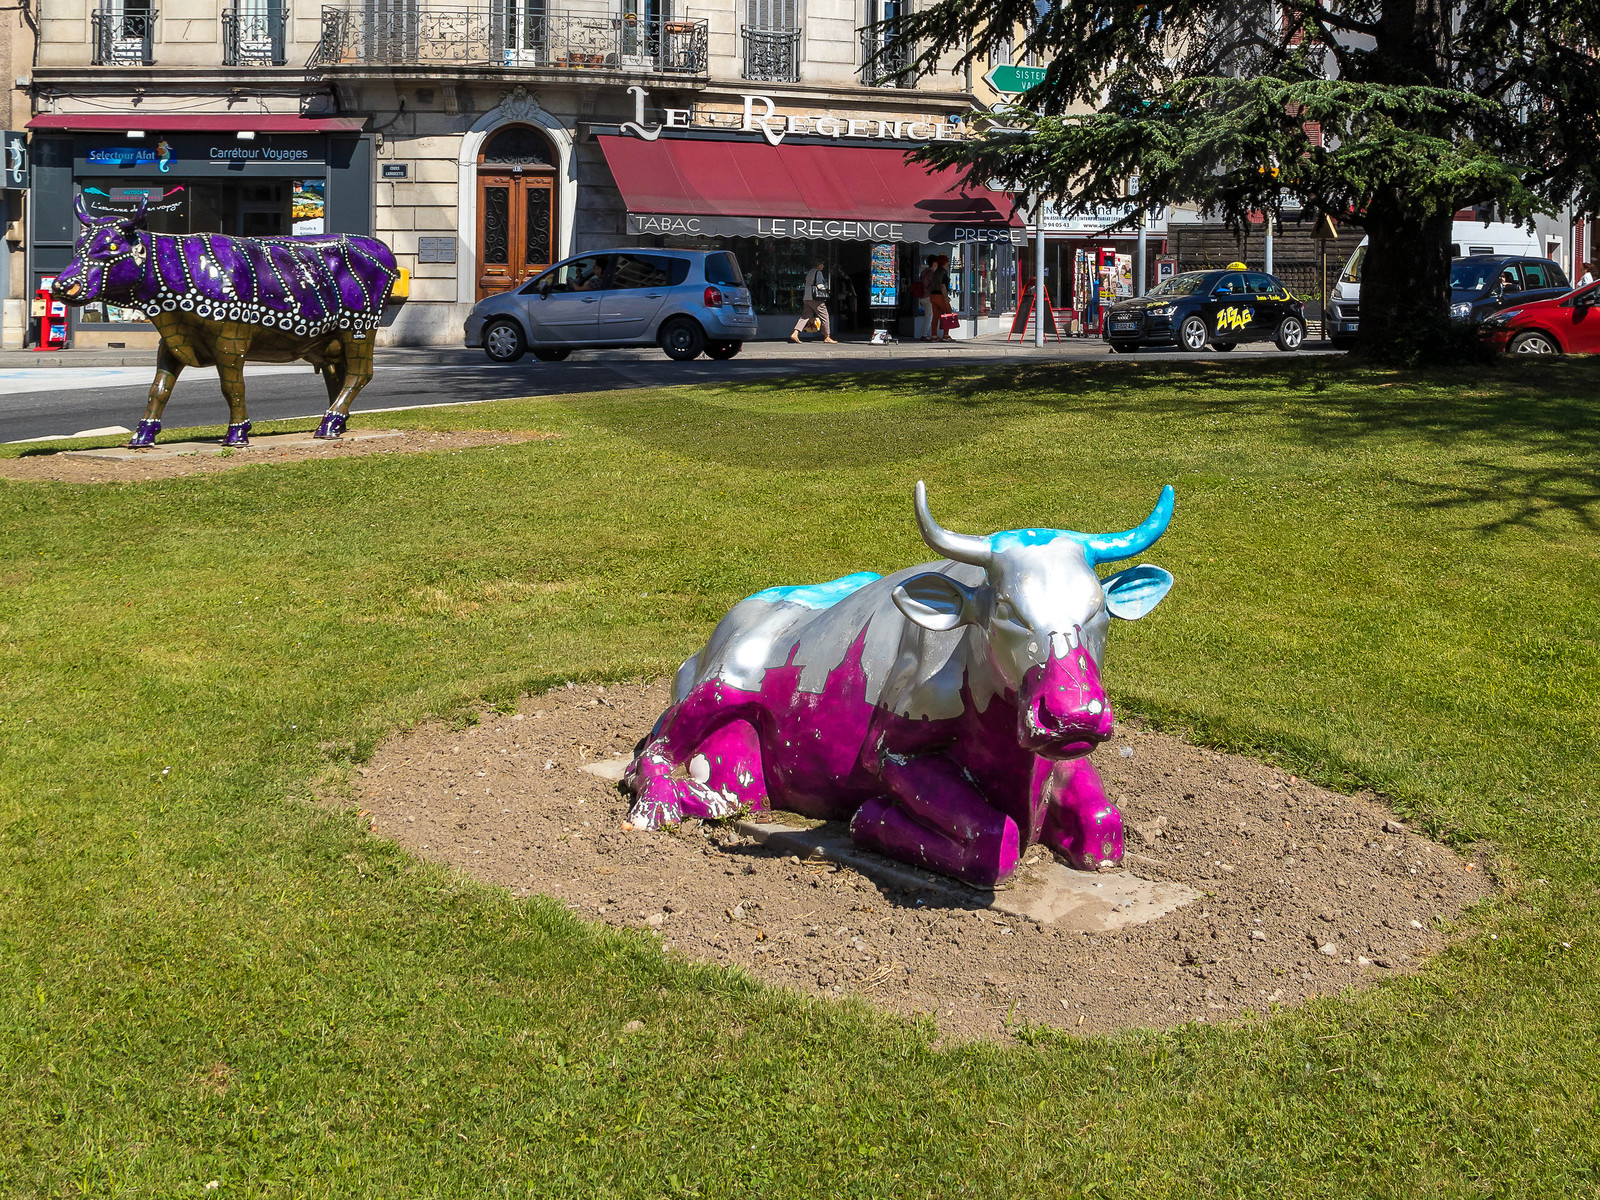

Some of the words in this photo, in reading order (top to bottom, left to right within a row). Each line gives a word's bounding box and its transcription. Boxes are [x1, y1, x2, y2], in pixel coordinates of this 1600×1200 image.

[1015, 70, 1046, 81] SISTER
[89, 150, 133, 160] Selectour
[135, 150, 156, 160] Afat
[209, 147, 260, 158] Carrétour
[261, 147, 309, 161] Voyages
[635, 215, 701, 232] TABAC
[757, 218, 786, 235] LE
[793, 220, 903, 239] REGENCE
[954, 227, 1022, 243] PRESSE
